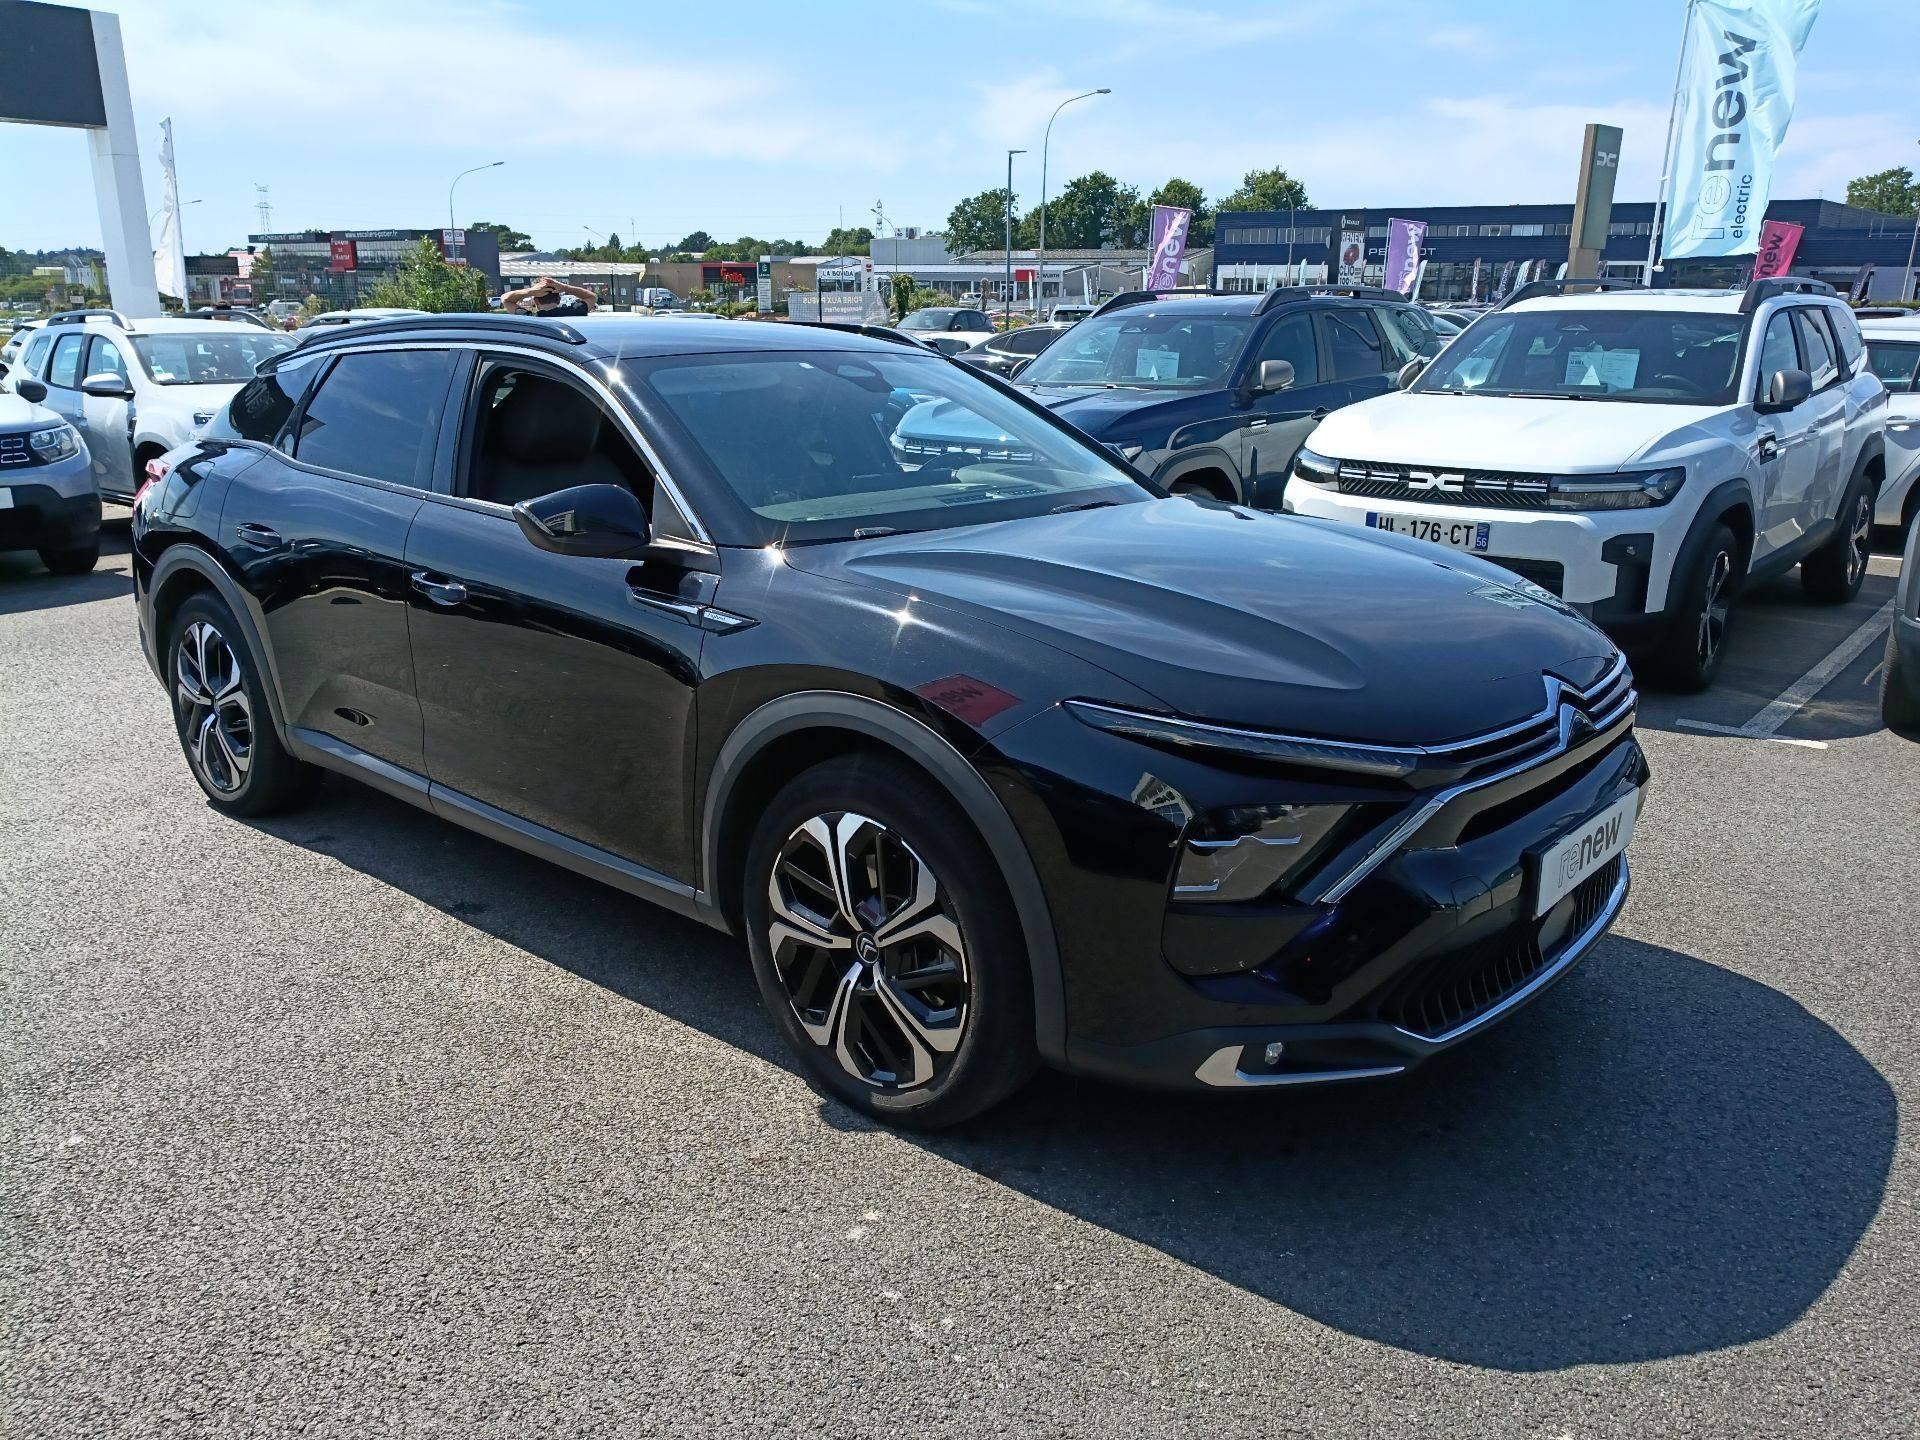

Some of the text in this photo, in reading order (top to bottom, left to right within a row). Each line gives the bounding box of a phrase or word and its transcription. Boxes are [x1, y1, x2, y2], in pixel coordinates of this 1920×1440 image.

[1691, 30, 1757, 240] renew
[1730, 174, 1753, 240] electric
[1341, 231, 1365, 243] RENEW
[1368, 247, 1437, 256] PEOT
[1339, 265, 1355, 277] CLIO
[1476, 537, 1488, 548] 56
[1558, 811, 1623, 888] renew
